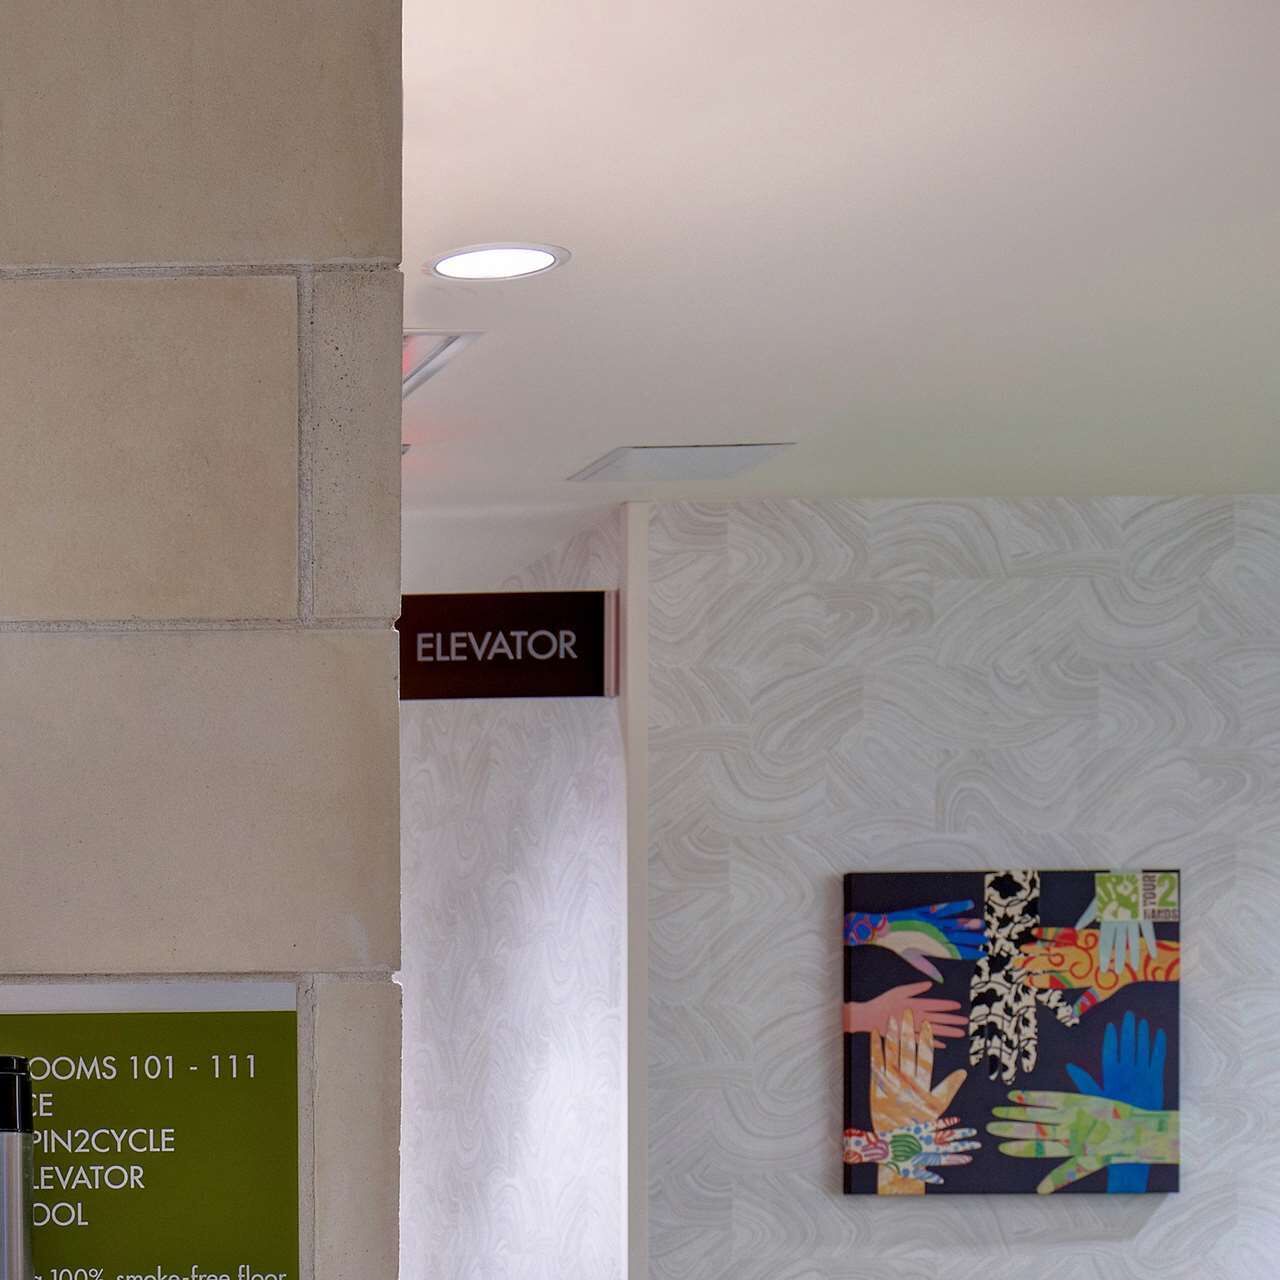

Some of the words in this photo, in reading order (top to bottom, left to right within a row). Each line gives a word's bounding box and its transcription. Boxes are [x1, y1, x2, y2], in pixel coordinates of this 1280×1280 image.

[416, 630, 578, 661] ELEVATOR
[1157, 873, 1177, 907] 2
[29, 1056, 117, 1080] OOMS
[130, 1056, 174, 1079] 101
[211, 1055, 256, 1078] 111
[33, 1129, 175, 1153] PIN2CYCLE
[33, 1165, 145, 1190] EVATOR
[33, 1203, 88, 1226] OOL
